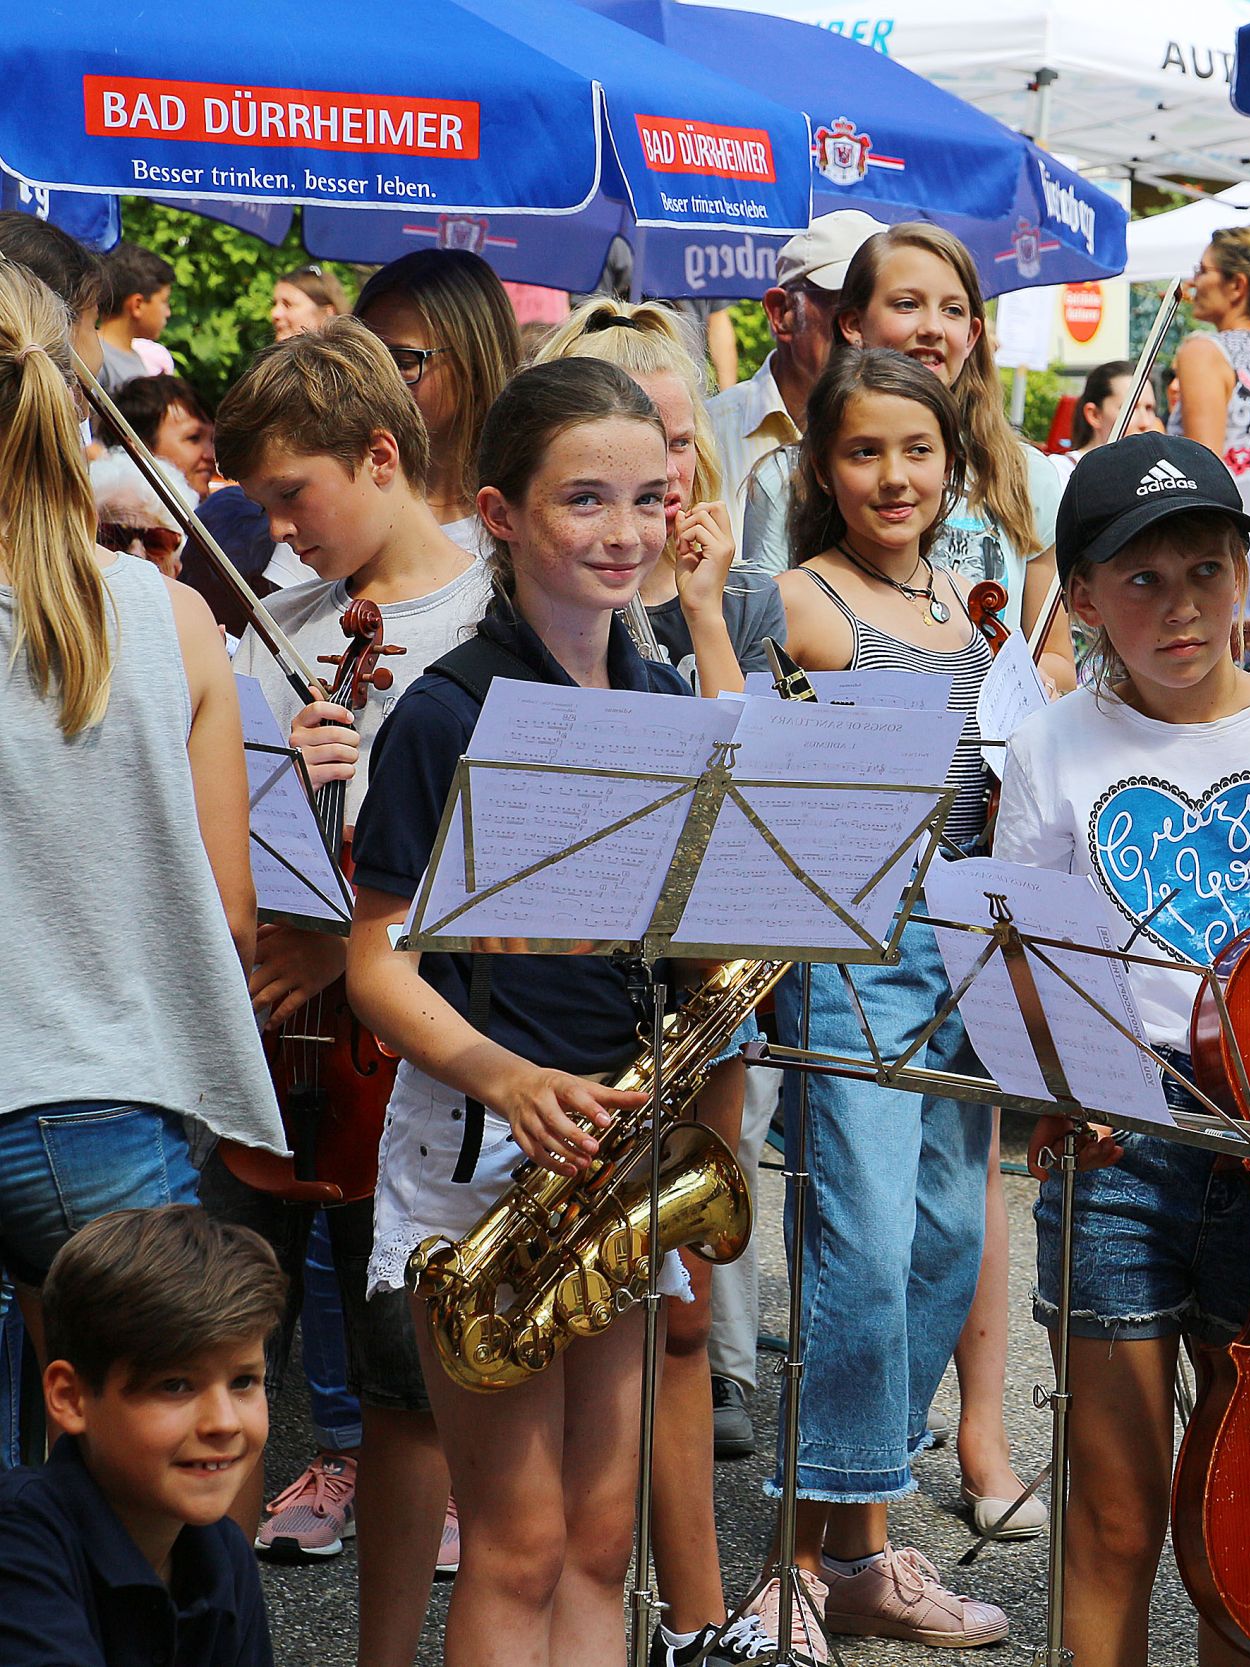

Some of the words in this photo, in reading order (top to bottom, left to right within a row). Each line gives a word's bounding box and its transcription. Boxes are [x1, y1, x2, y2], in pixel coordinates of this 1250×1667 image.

[103, 91, 186, 131] BAD
[204, 90, 463, 150] DÜRRHEIMER
[642, 128, 674, 165] BAD
[677, 124, 769, 175] DÜRRHEIMER
[131, 159, 203, 184] Besser
[211, 167, 297, 191] trinken,
[305, 173, 369, 195] besser
[376, 174, 438, 198] leben.
[1135, 475, 1199, 497] adidas
